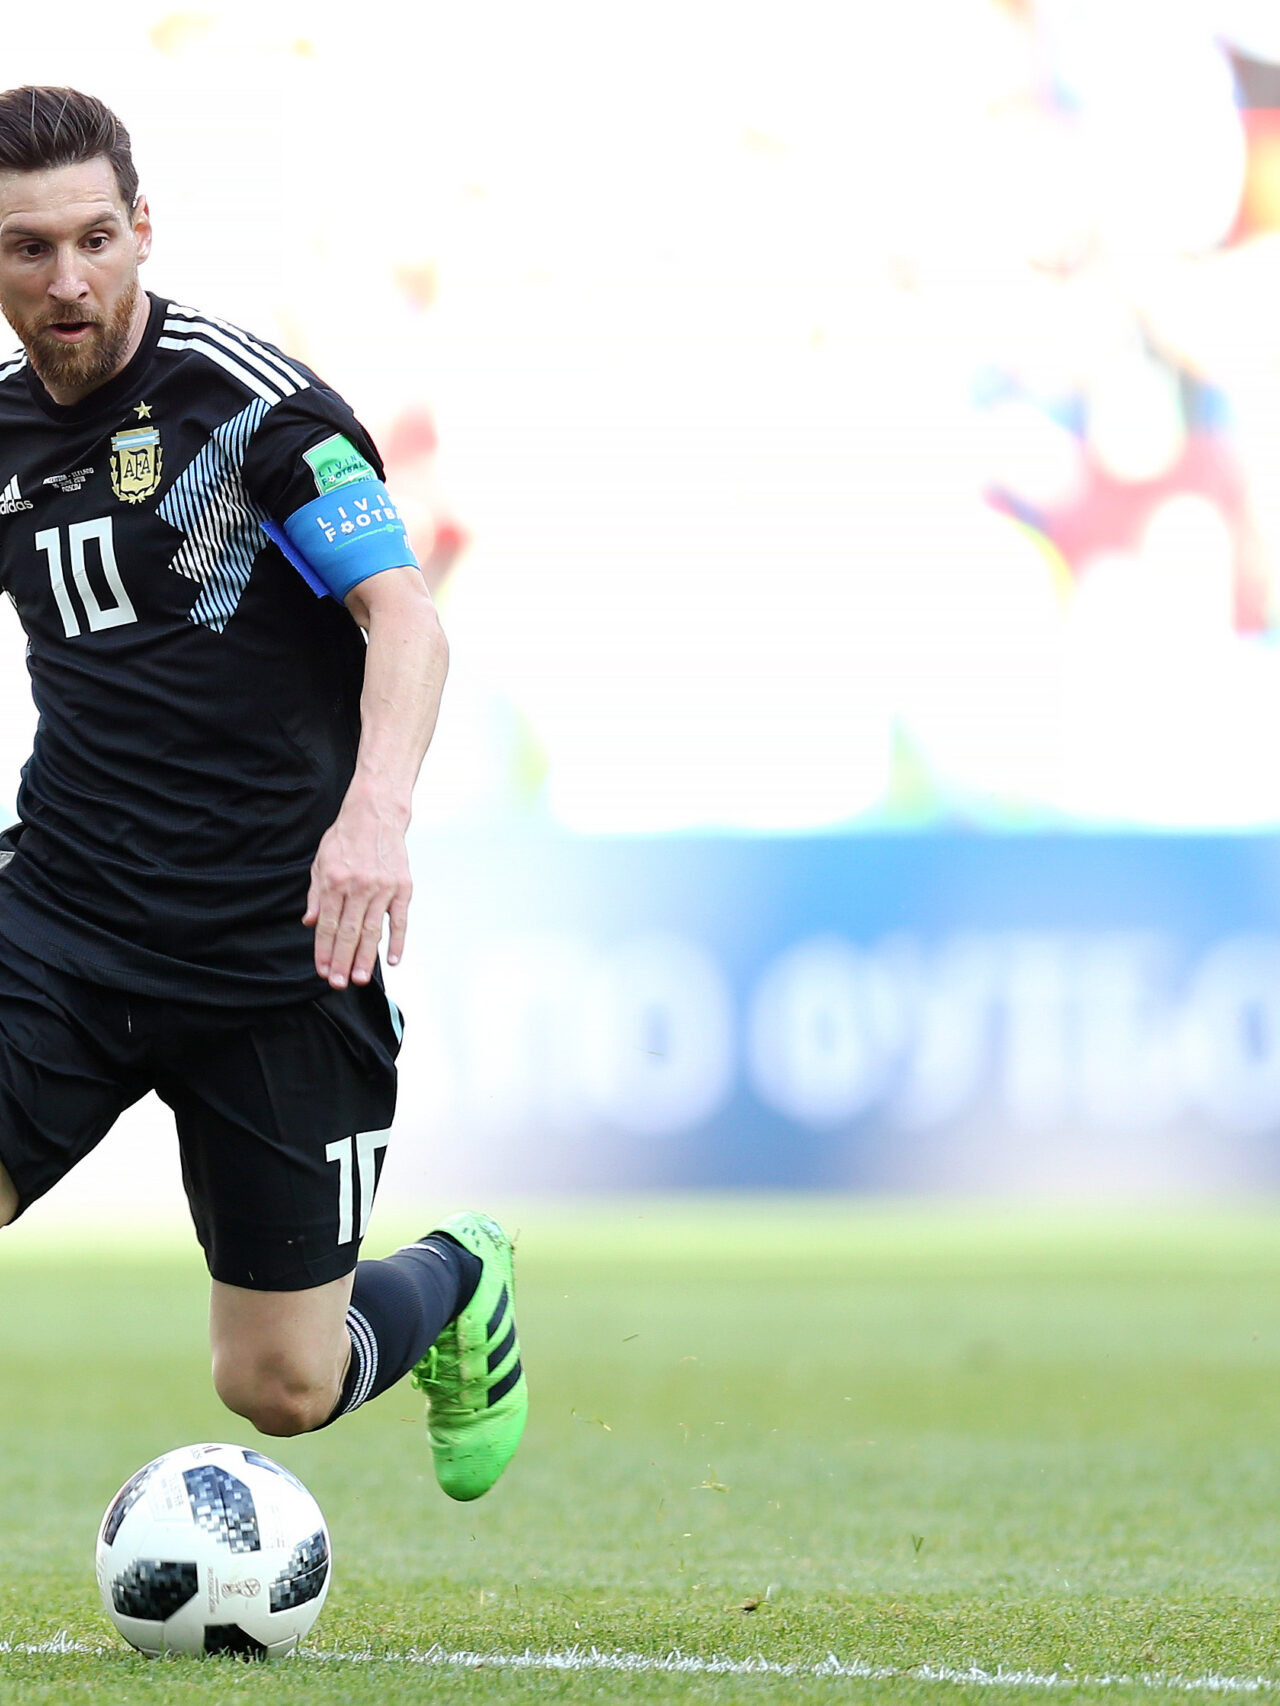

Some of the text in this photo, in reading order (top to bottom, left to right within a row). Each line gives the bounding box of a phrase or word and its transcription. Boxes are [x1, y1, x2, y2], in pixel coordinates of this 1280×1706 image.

[123, 449, 151, 480] AFA
[316, 494, 394, 530] LIVI
[324, 506, 401, 543] FOOTB
[34, 515, 139, 639] 10
